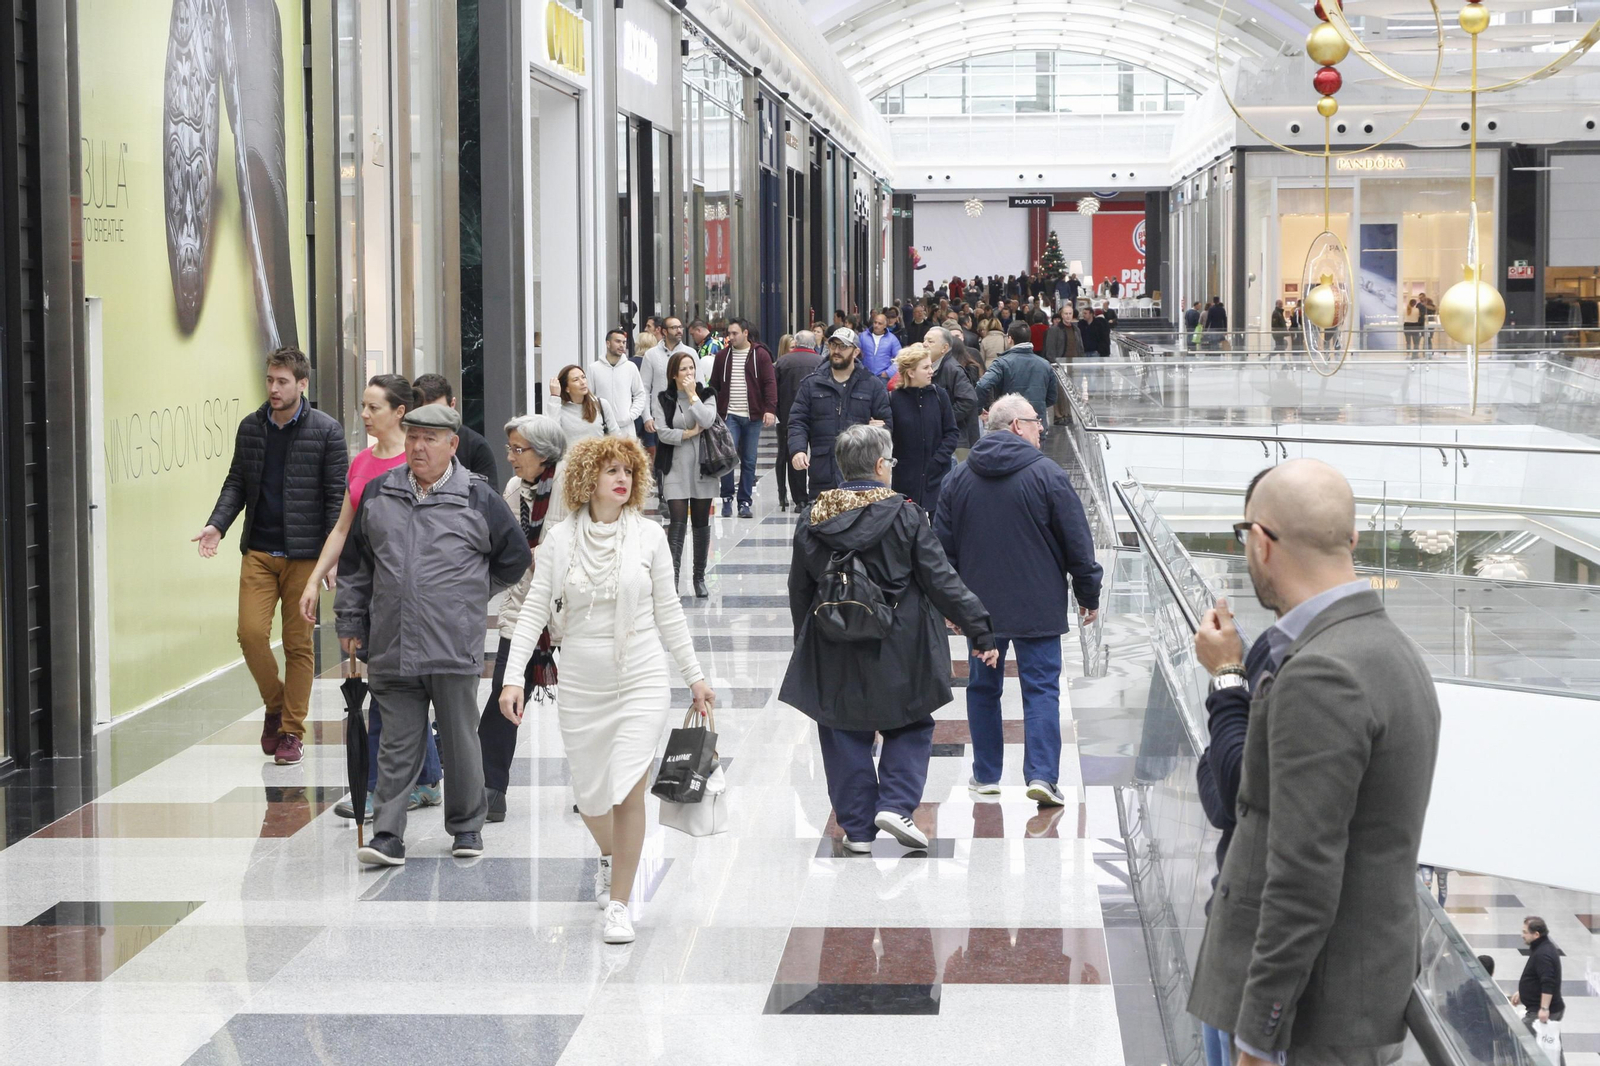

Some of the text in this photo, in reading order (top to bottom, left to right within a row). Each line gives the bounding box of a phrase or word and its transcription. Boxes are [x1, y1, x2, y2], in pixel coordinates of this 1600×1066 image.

[1337, 156, 1405, 170] PANDORA
[94, 218, 124, 242] BREATHE
[149, 403, 199, 475] SOON
[203, 397, 240, 460] SS17
